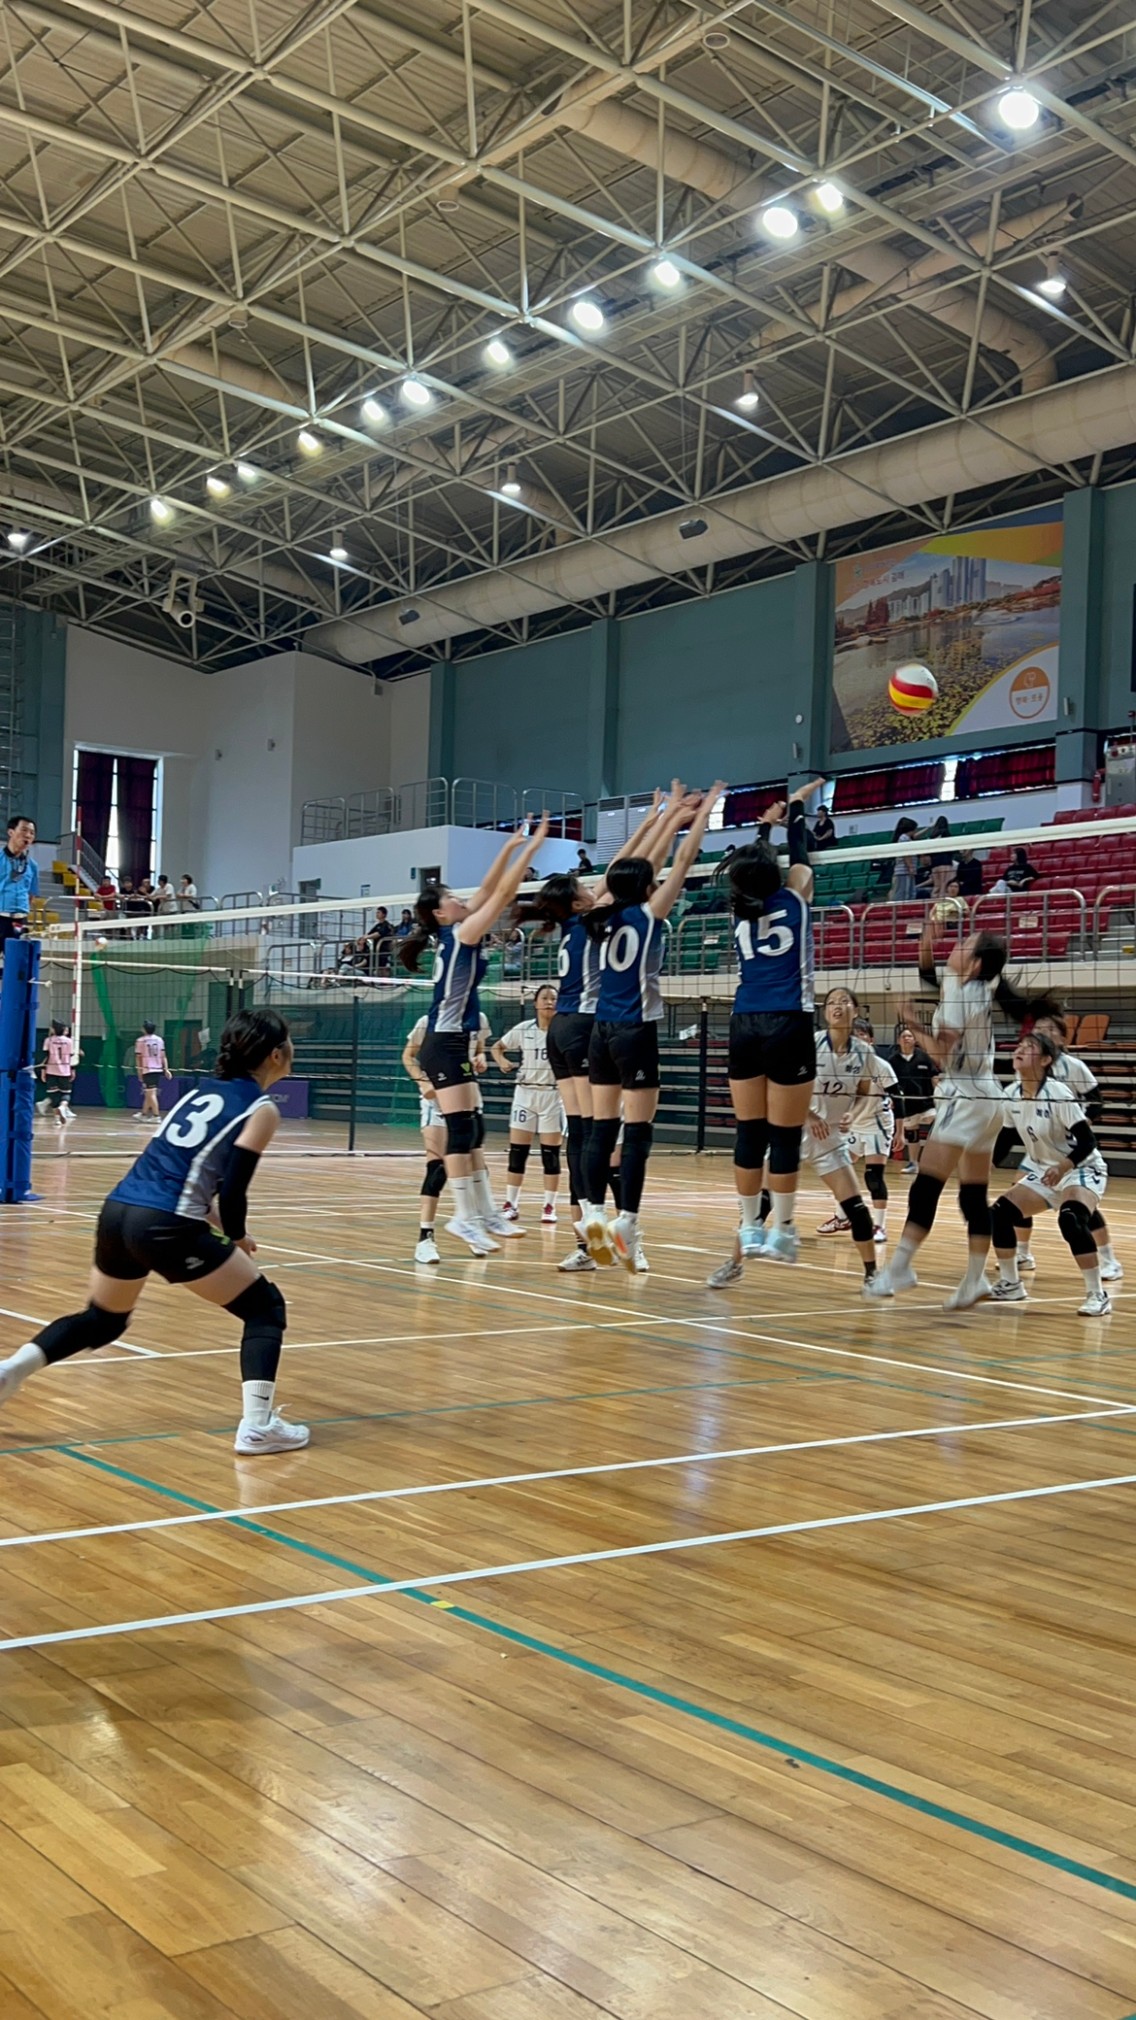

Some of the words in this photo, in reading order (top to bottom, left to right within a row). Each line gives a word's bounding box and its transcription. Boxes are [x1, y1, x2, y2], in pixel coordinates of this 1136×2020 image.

[599, 925, 640, 972] 10
[735, 909, 794, 960] 15
[534, 1048, 548, 1060] 16
[822, 1081, 843, 1097] 12
[152, 1089, 225, 1148] 13
[513, 1109, 527, 1122] 16
